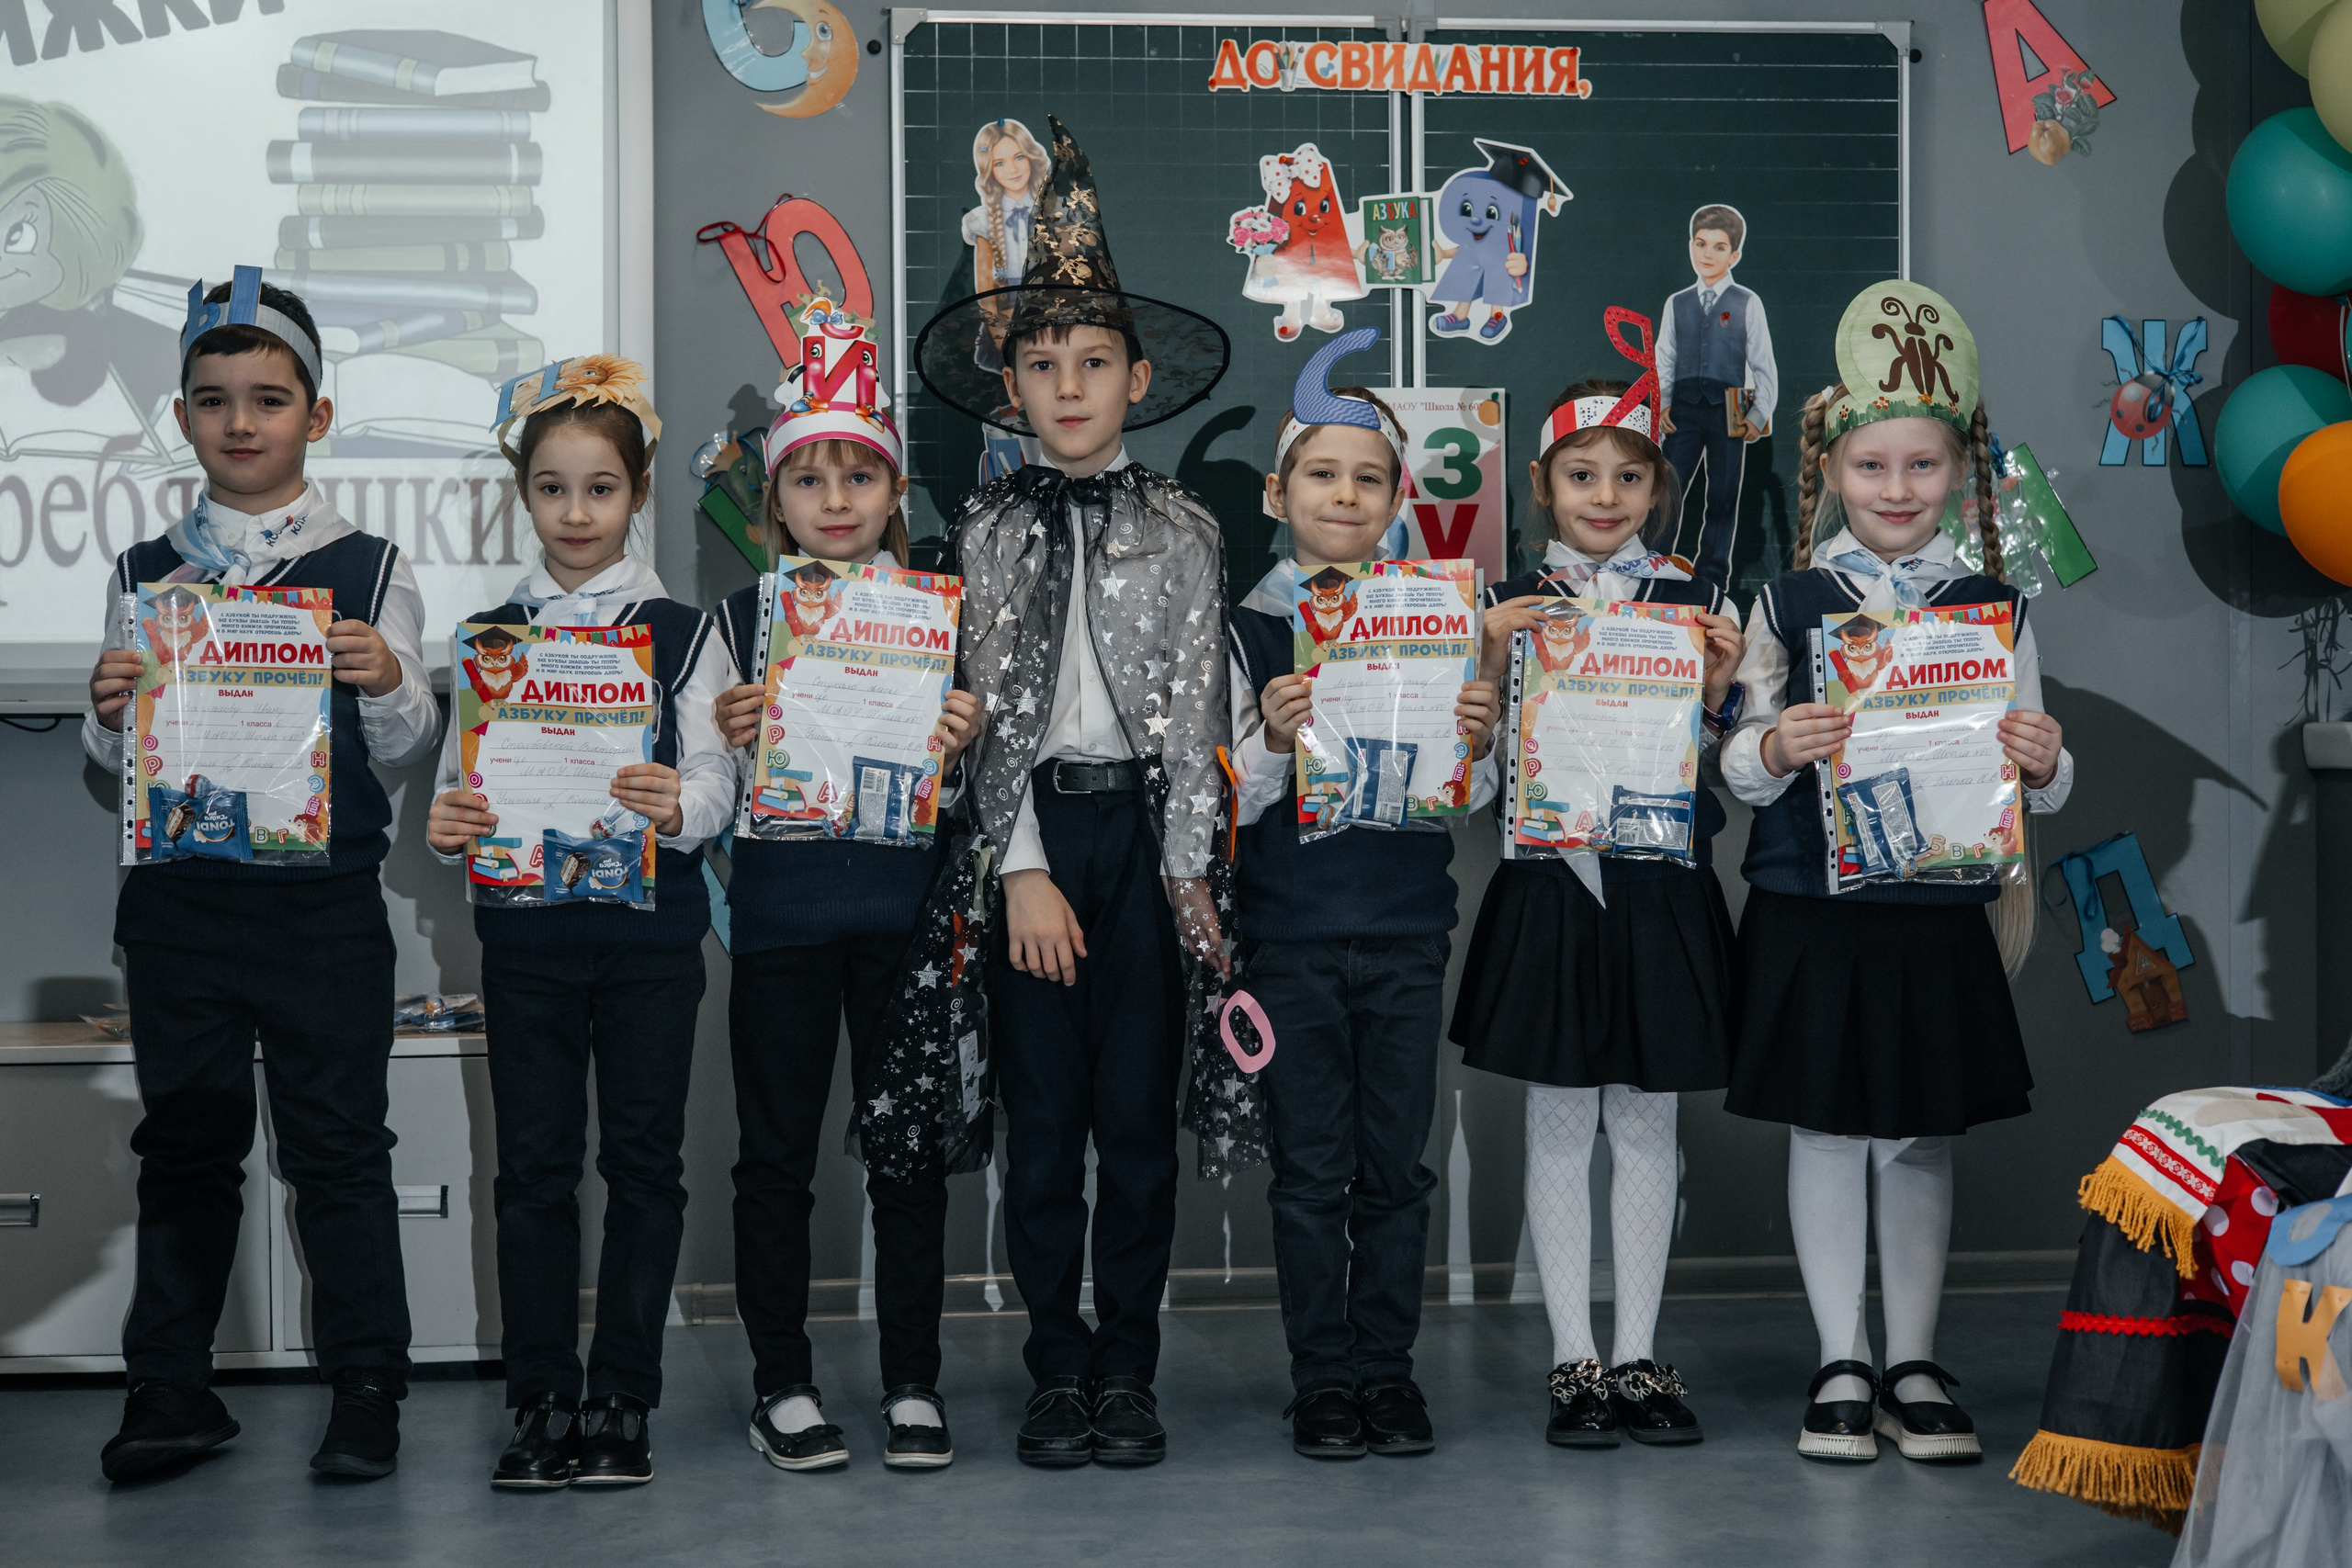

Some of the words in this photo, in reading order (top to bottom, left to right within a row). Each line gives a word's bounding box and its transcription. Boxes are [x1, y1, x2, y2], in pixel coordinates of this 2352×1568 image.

[1213, 41, 1283, 89] ДО
[1303, 43, 1591, 97] СВИДАНИЯ,
[1373, 201, 1417, 220] АЗБУКА
[830, 616, 952, 649] ДИПЛОМ
[1350, 614, 1467, 641] ДИПЛОМ
[806, 643, 873, 661] АЗБУКУ
[878, 652, 947, 670] ПРОЧЁЛ!
[1329, 646, 1392, 659] АЗБУКУ
[1398, 641, 1466, 659] ПРОЧЁЛ!
[845, 666, 877, 677] ВЫДАН
[1367, 663, 1399, 671] ВЫДАН
[1579, 651, 1697, 678] ДИПЛОМ
[1885, 658, 2007, 689] ДИПЛОМ
[175, 669, 245, 682] АЗБУКУ
[253, 671, 322, 684] ПРОЧЁЛ!
[219, 689, 253, 697] ВЫДАН
[521, 680, 645, 702] ДИПЛОМ
[791, 691, 812, 699] учени
[1557, 678, 1622, 694] АЗБУКУ
[1627, 683, 1694, 698] ПРОЧЁЛ!
[1863, 693, 1929, 708] АЗБУКУ
[1938, 684, 2007, 705] ПРОЧЁЛ!
[1596, 698, 1627, 707] ВЫДАН
[497, 707, 567, 721] АЗБУКУ
[574, 710, 644, 723] ПРОЧЁЛ!
[541, 727, 574, 735] ВЫДАН
[1857, 745, 1878, 753] учени
